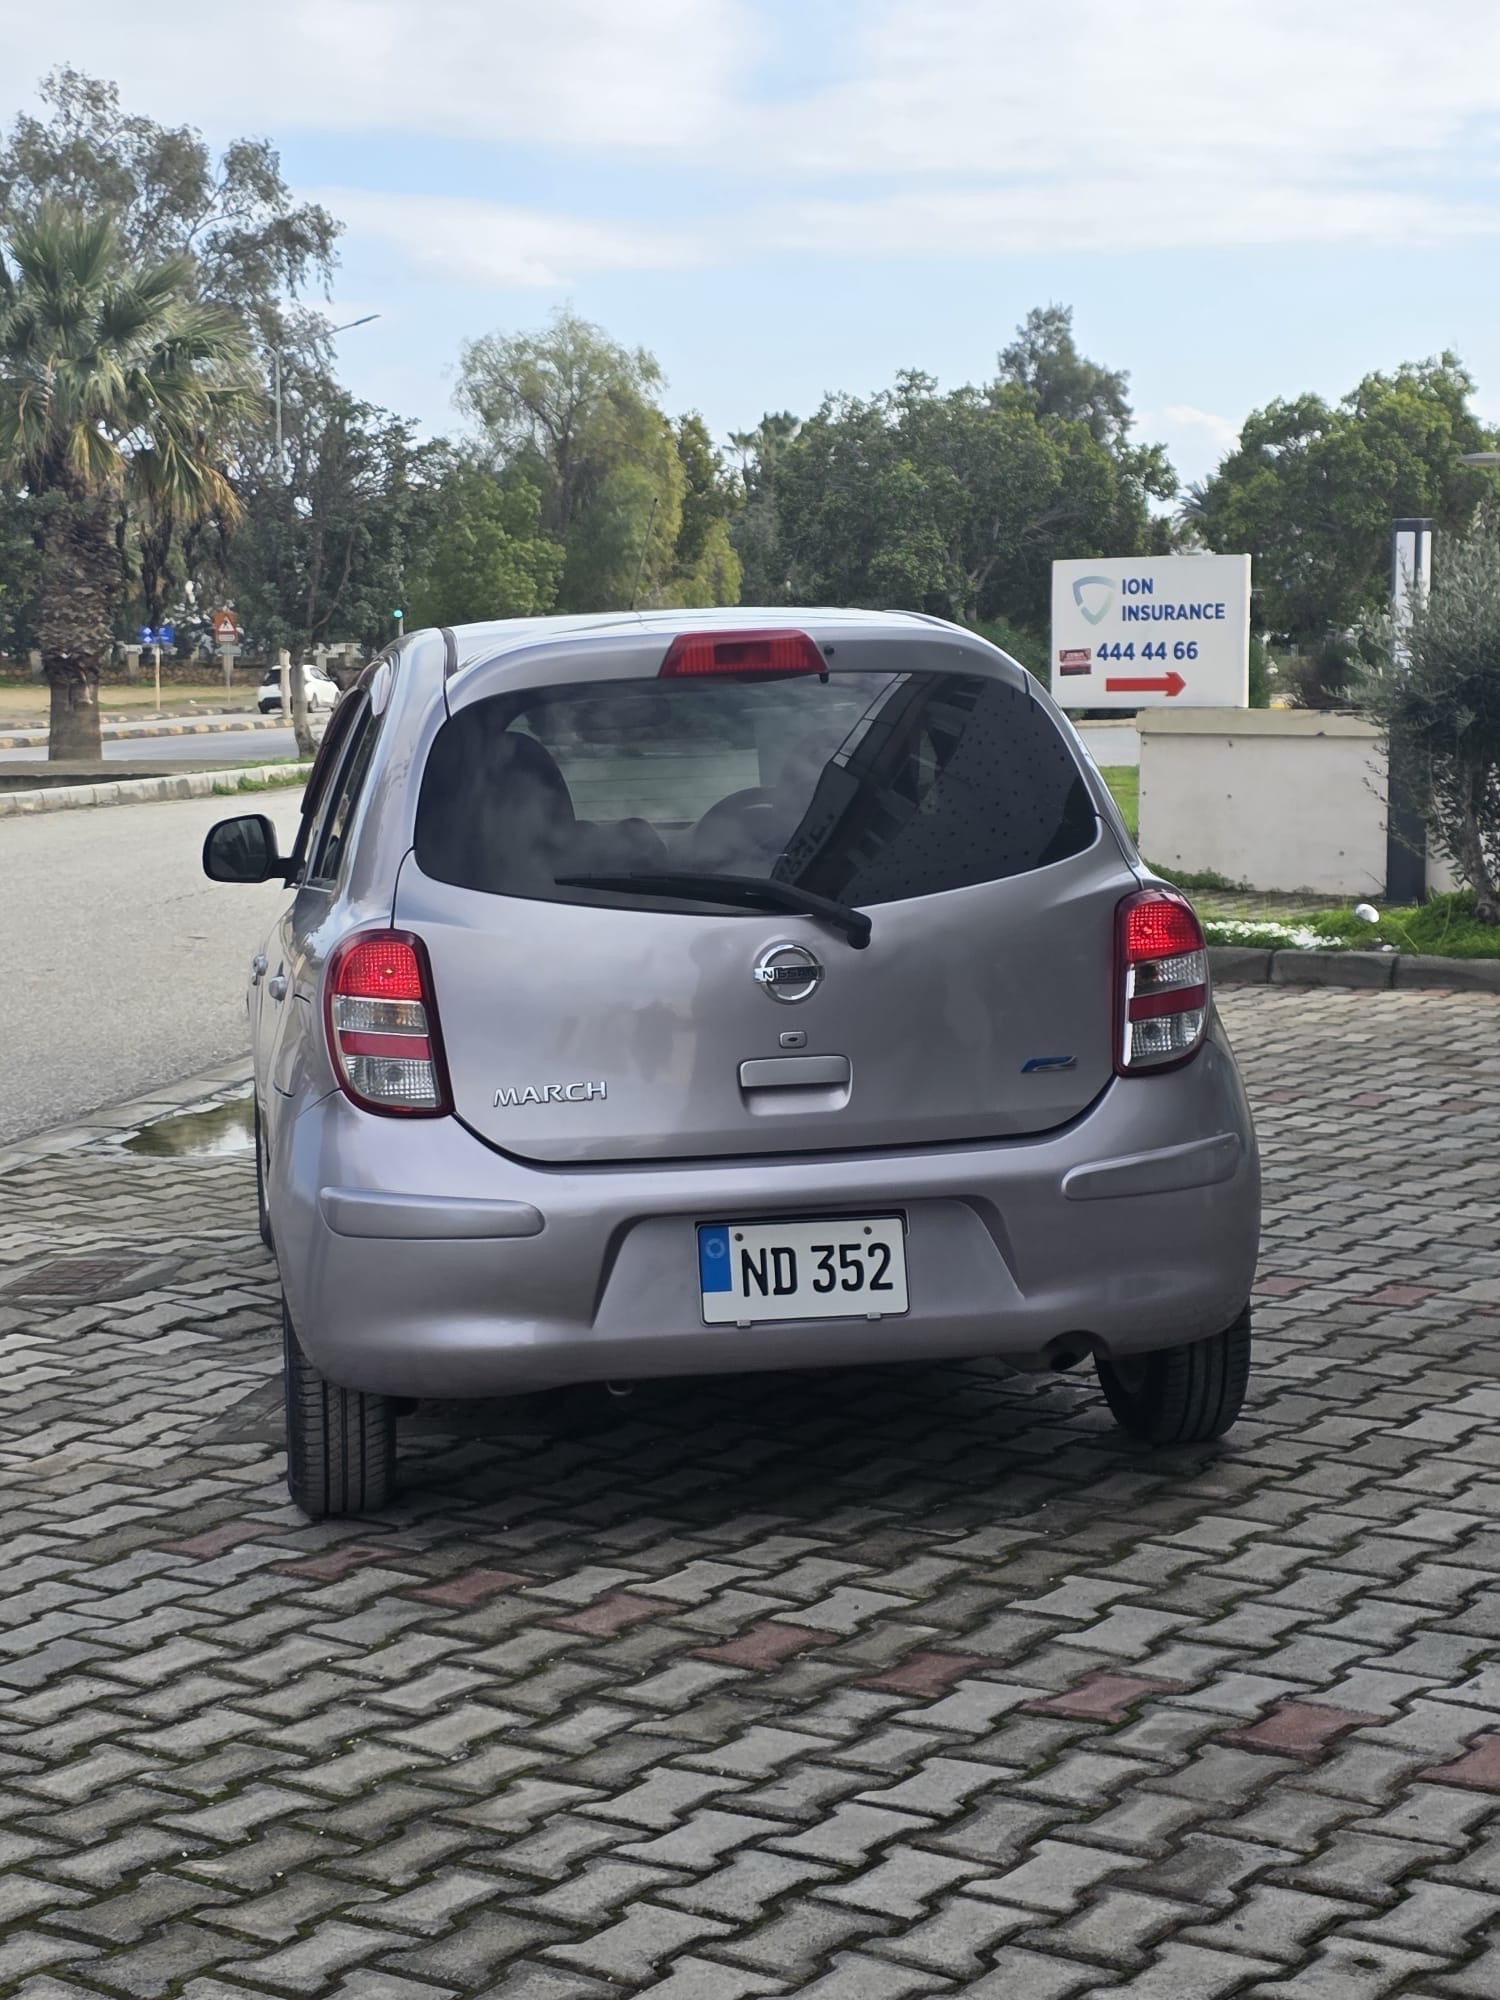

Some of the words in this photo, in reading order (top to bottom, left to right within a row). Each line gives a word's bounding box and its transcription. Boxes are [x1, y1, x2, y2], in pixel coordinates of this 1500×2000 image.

[1121, 578, 1154, 595] ION
[1121, 603, 1226, 622] INSURANCE
[1096, 642, 1135, 661] 444
[1141, 641, 1167, 660] 44
[1173, 641, 1199, 660] 66
[493, 1081, 607, 1107] MARCH
[741, 1247, 798, 1297] ND
[810, 1242, 894, 1293] 352
